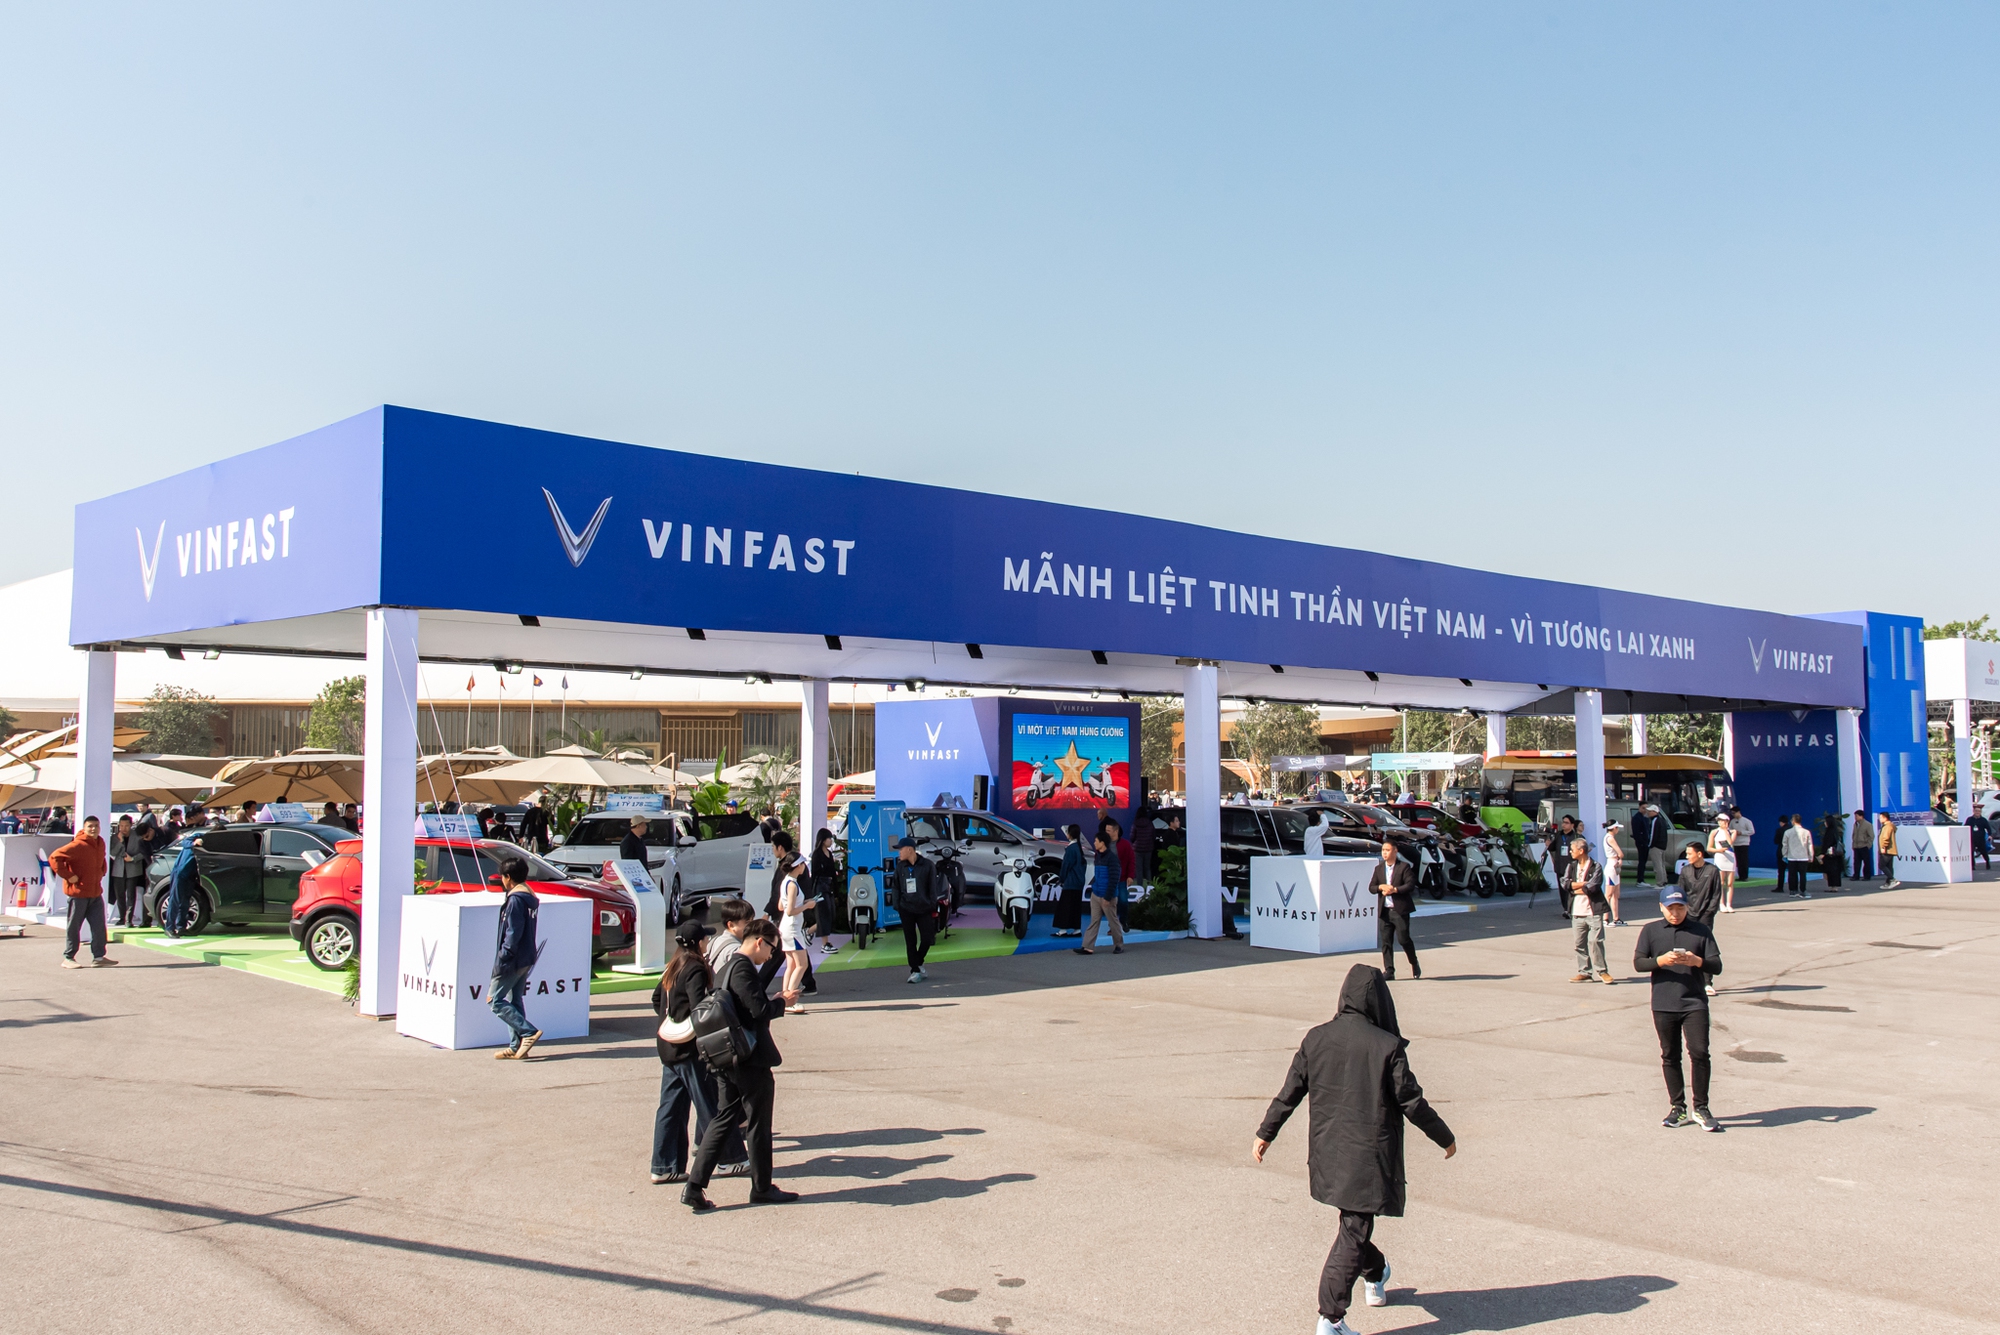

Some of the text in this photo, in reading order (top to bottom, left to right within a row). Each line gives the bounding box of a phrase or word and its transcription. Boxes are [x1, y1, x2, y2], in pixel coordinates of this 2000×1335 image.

[176, 505, 295, 578] VINFAST
[641, 518, 855, 576] VINFAST
[1003, 551, 1112, 601] MÃNH
[1128, 565, 1197, 614] LIỆT
[1209, 580, 1279, 618] TINH
[1290, 585, 1362, 626] THẦN
[1372, 597, 1427, 639] VIỆT
[1436, 609, 1485, 640] NAM
[1510, 612, 1534, 645] VÌ
[1541, 620, 1611, 651] TƯƠNG
[1617, 630, 1644, 655] LAI
[1649, 633, 1695, 660] XANH
[1773, 648, 1833, 674] VINFAST
[1061, 726, 1078, 736] NAM
[1750, 733, 1835, 748] VINFAS
[907, 749, 960, 760] VINFAST
[439, 823, 456, 833] 457
[1897, 855, 1947, 863] VINFAST
[1256, 906, 1317, 921] VINFAST
[1325, 906, 1375, 920] VINFAST
[403, 973, 454, 1000] VINFAST
[469, 977, 582, 1000] VFAST
